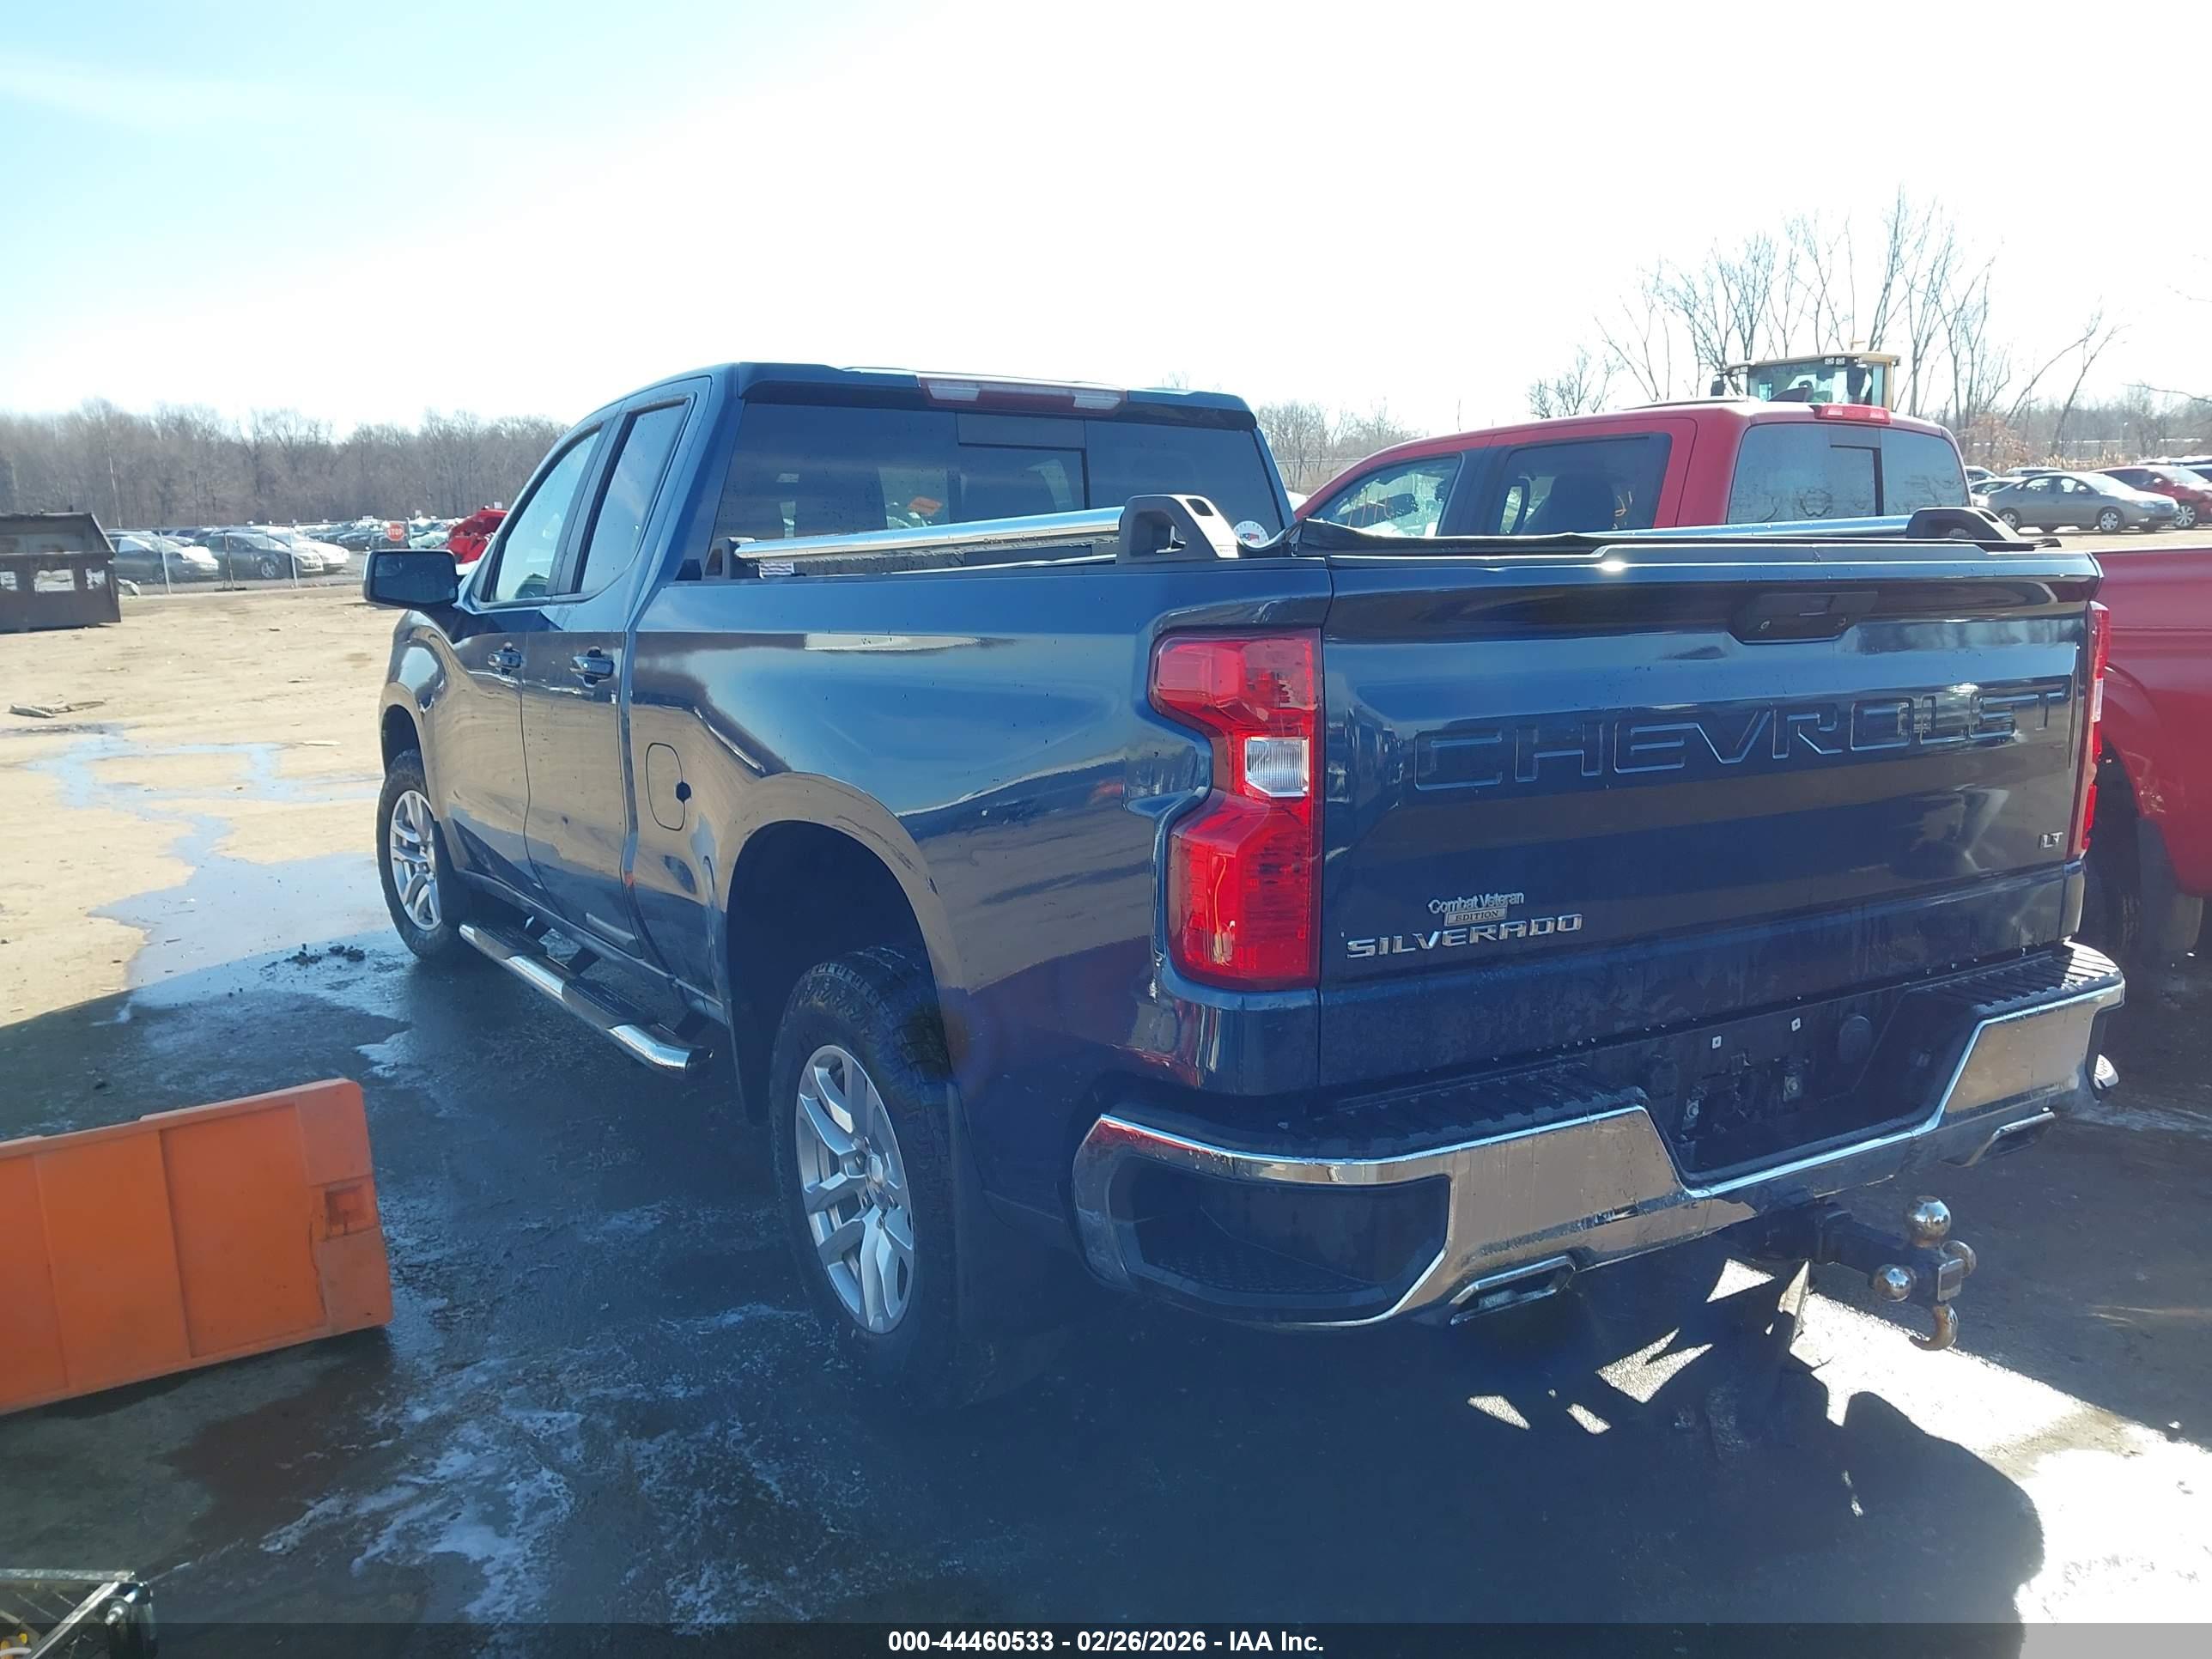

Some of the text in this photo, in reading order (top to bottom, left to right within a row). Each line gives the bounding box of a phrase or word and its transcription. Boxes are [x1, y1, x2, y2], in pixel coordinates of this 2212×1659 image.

[1413, 686, 2069, 791] CHEVROLET
[2039, 831, 2063, 849] LT
[1428, 892, 1524, 914] Combat Veteran
[1455, 909, 1499, 921] EDITION
[1346, 914, 1583, 959] SILVERADO
